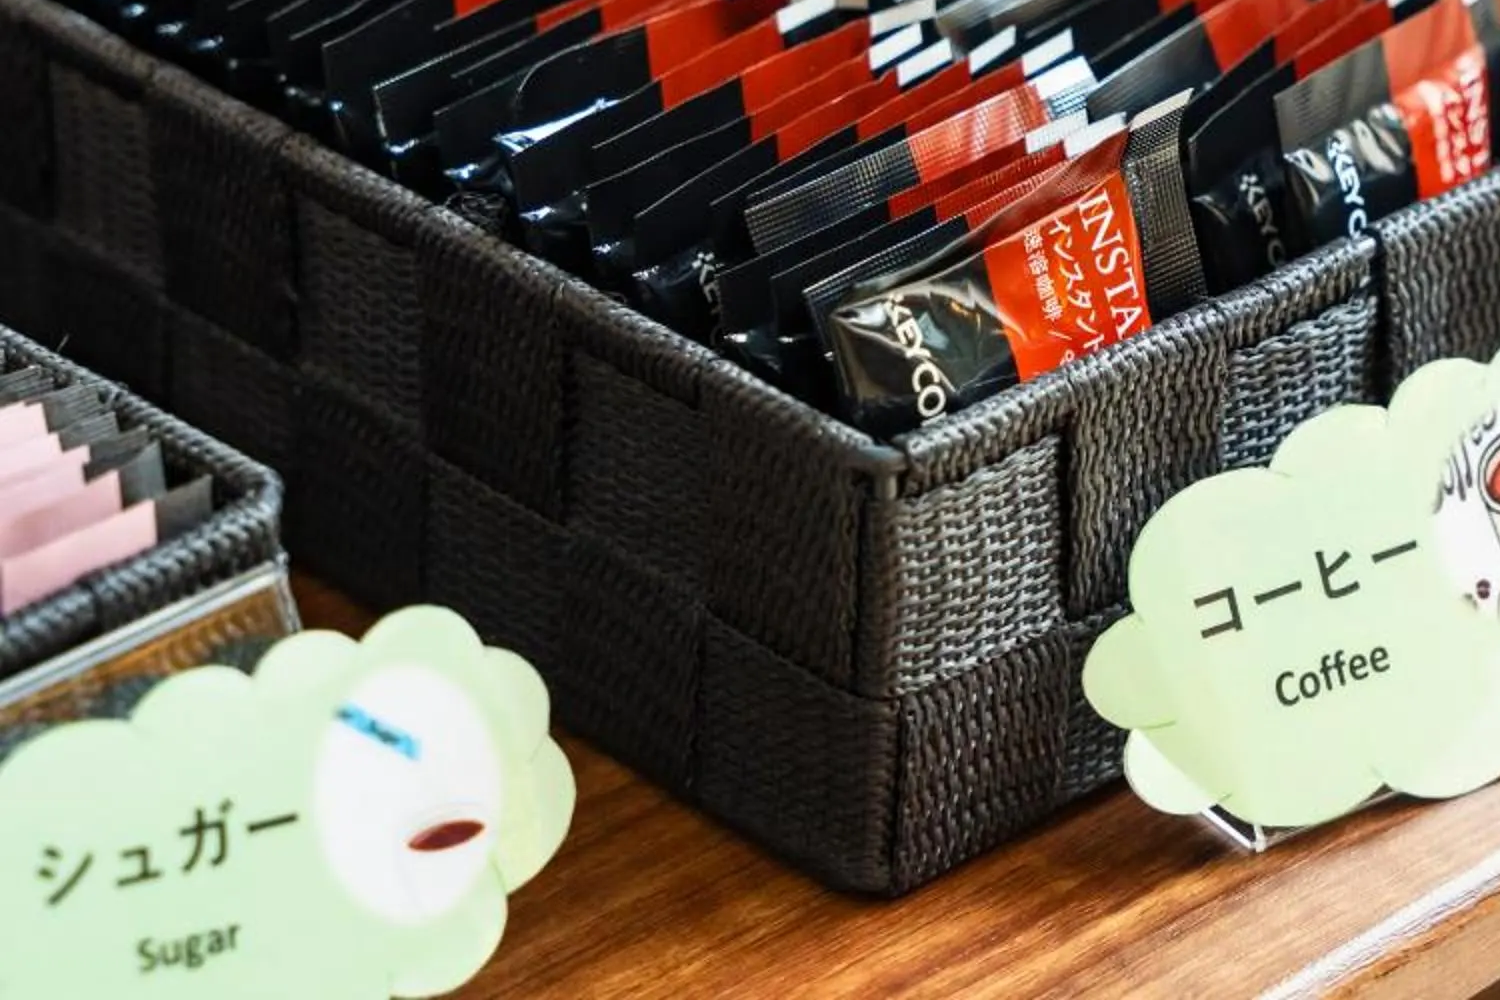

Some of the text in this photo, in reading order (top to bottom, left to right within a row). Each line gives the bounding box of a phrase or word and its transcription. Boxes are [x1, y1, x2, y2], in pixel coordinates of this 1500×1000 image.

[1078, 188, 1147, 340] INSTA
[911, 359, 948, 428] CO
[1193, 539, 1418, 639] コーヒー
[1274, 645, 1392, 707] Coffee
[36, 798, 299, 905] シュガー
[136, 924, 241, 973] Sugar
